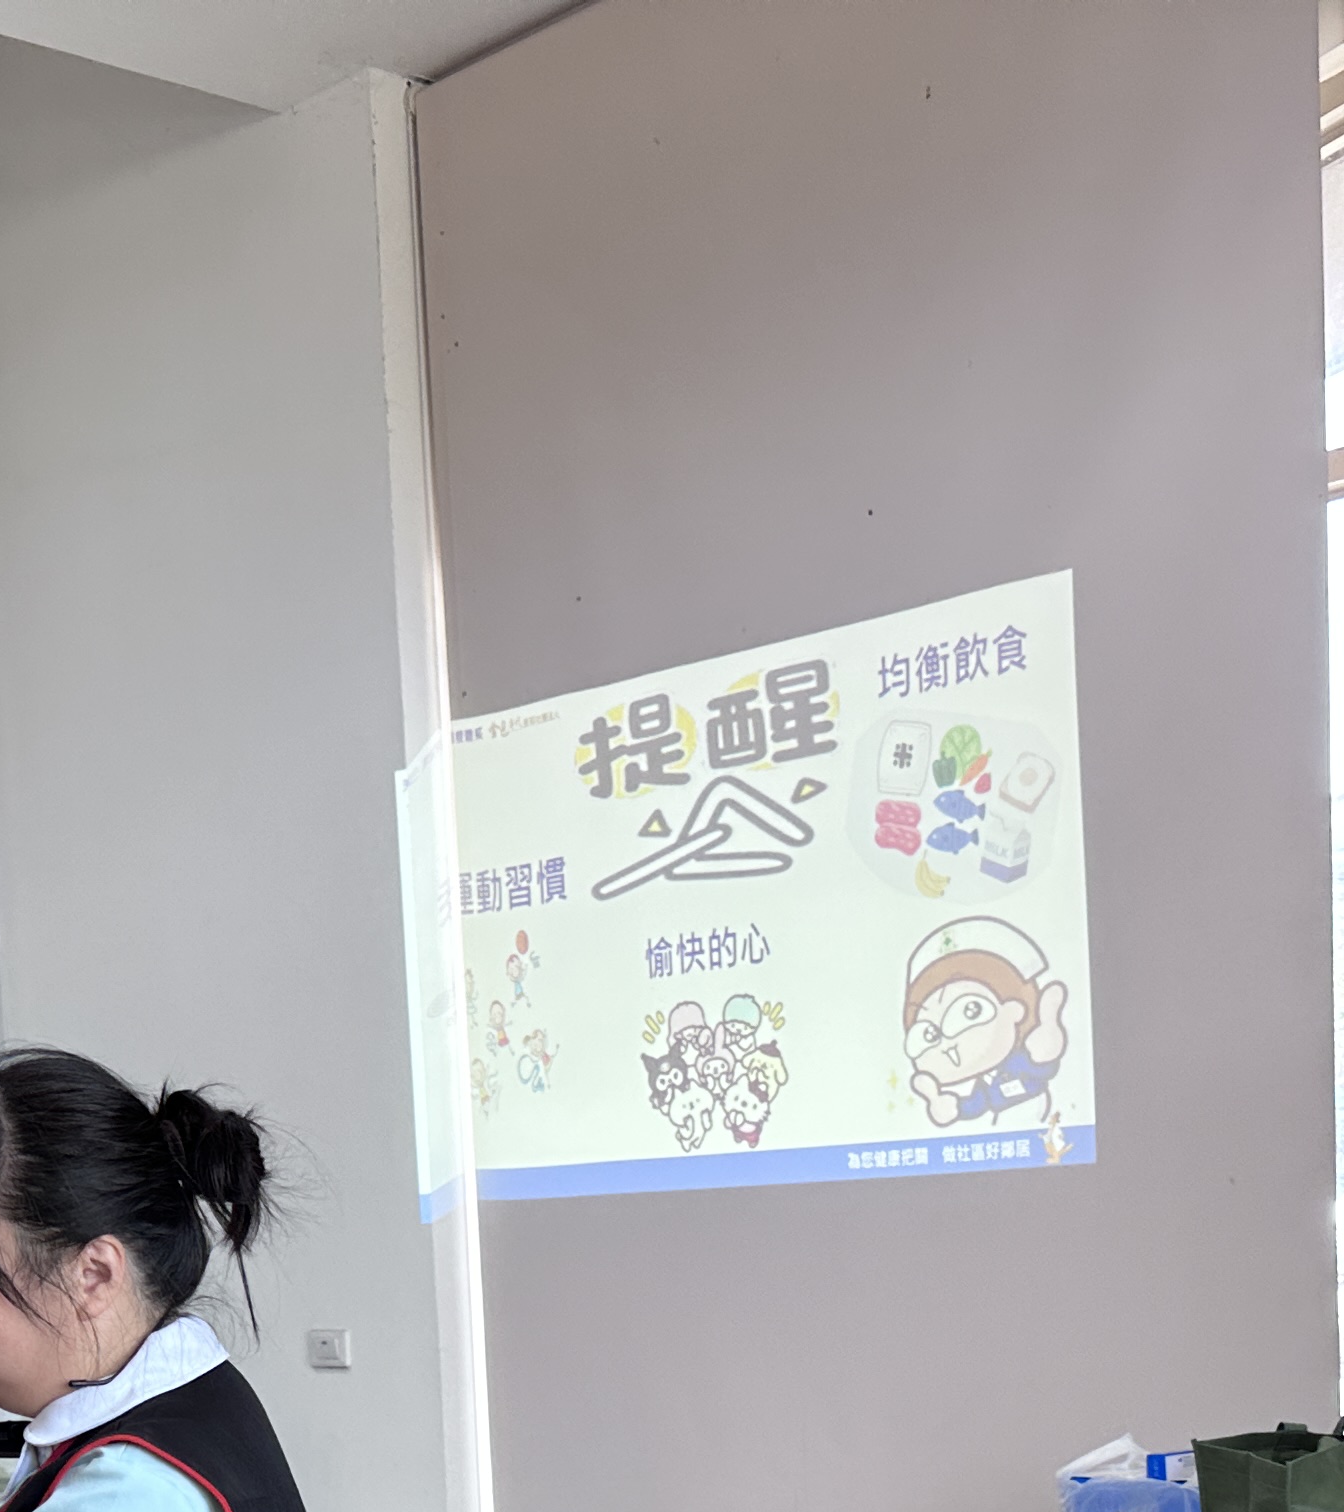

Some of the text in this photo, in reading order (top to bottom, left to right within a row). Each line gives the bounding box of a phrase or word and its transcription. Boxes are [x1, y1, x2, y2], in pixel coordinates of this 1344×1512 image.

[876, 624, 1029, 698] 均衡飲食
[577, 658, 839, 800] 提醒
[646, 923, 771, 979] 愉快的心
[942, 1139, 1031, 1163] 做社區好鄰居
